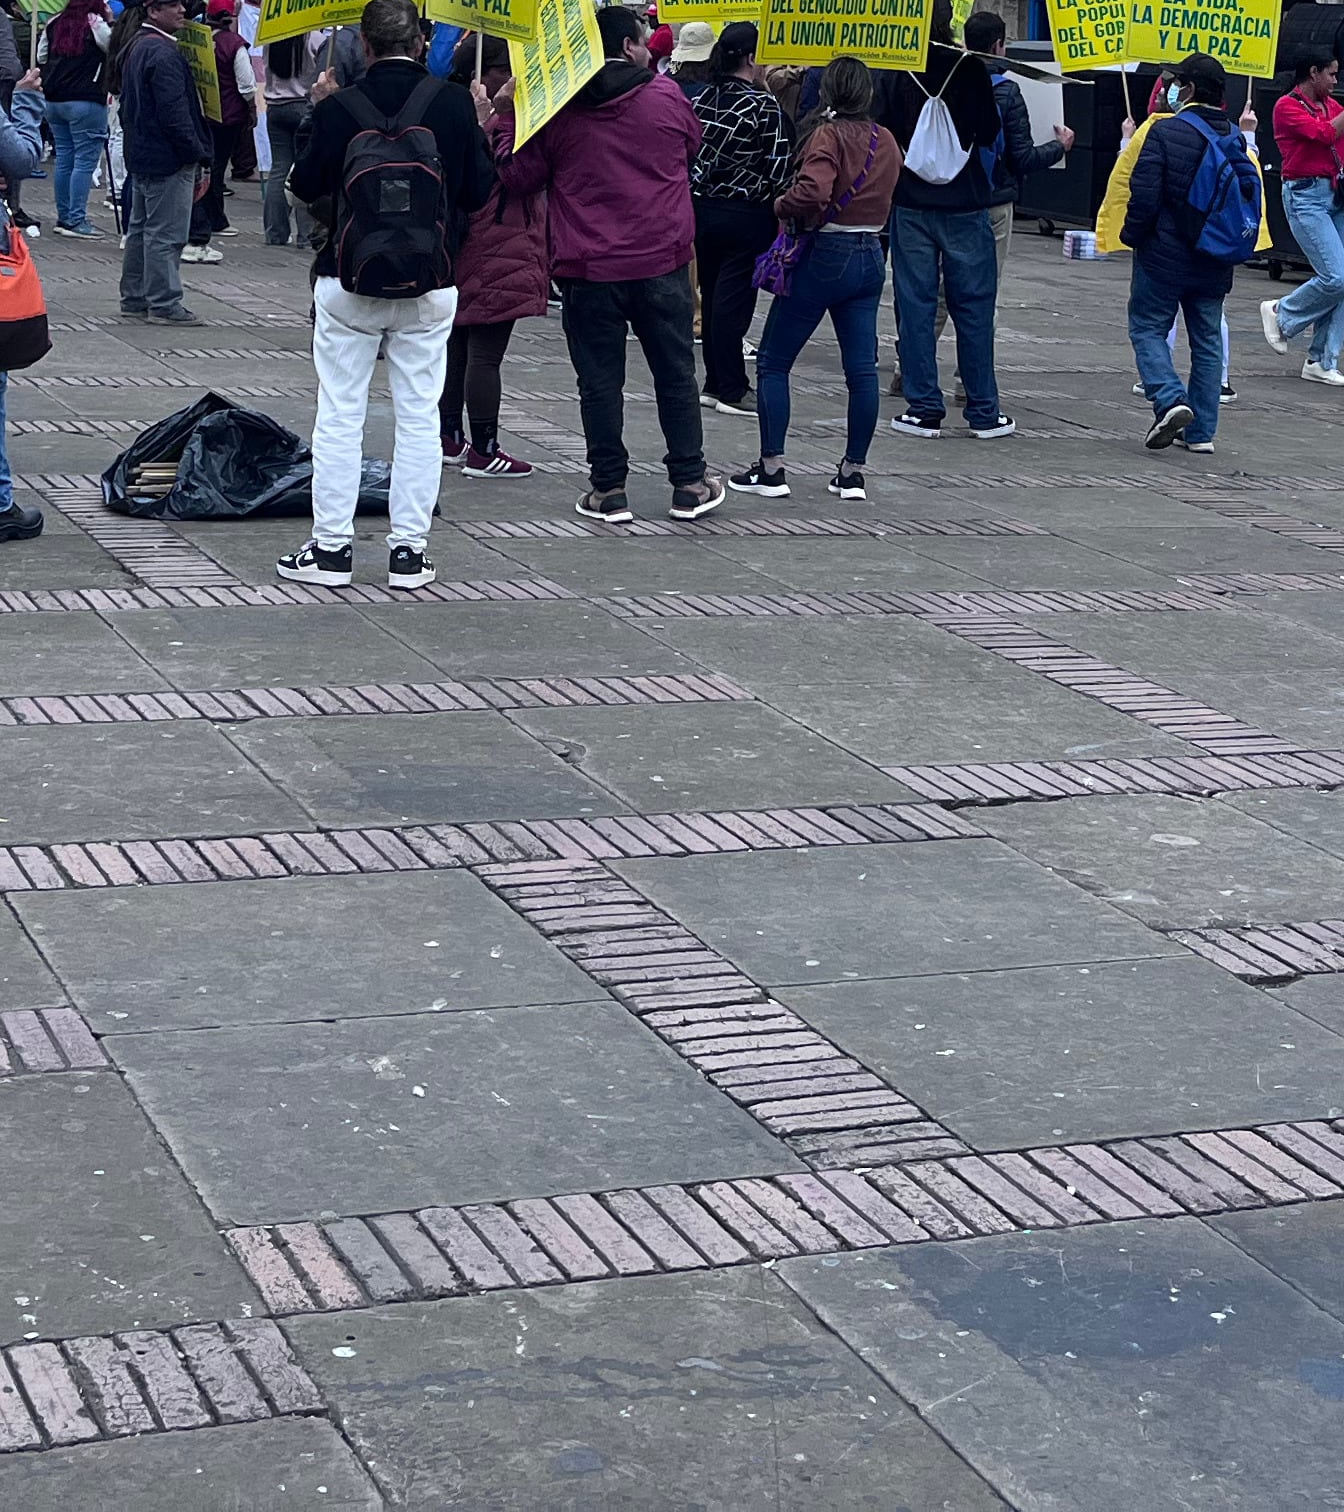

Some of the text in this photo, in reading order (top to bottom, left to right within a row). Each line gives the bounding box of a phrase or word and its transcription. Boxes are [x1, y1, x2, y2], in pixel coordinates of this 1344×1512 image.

[768, 17, 919, 51] LA UNIÓN PATRIÓTICA
[1058, 25, 1088, 43] DEL
[1132, 3, 1271, 38] LA DEMOCRACIA
[1068, 41, 1099, 58] DEL
[1159, 29, 1243, 58] Y LA PAZ
